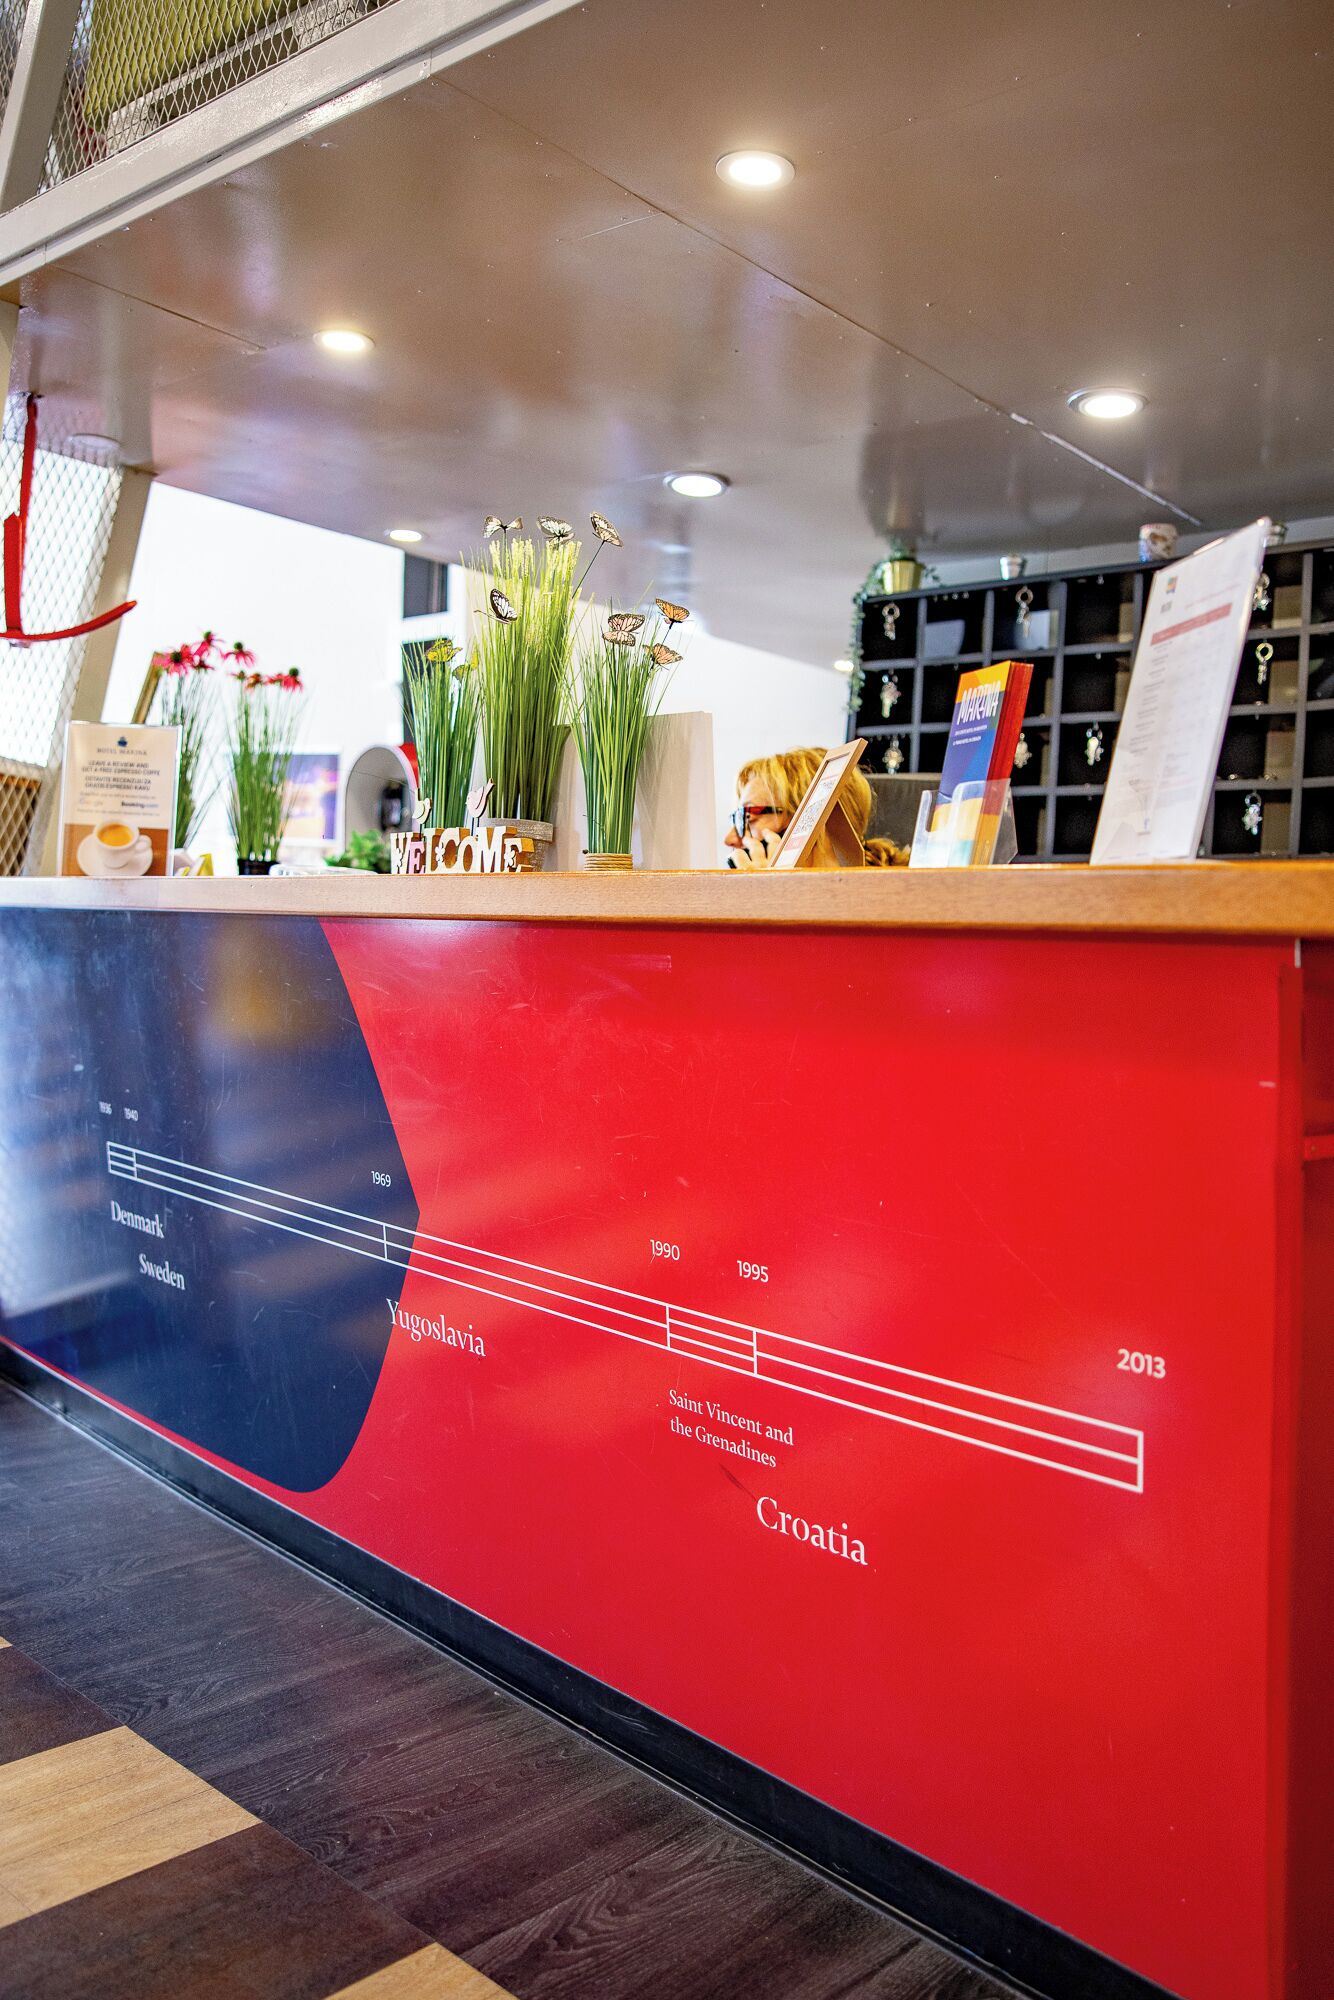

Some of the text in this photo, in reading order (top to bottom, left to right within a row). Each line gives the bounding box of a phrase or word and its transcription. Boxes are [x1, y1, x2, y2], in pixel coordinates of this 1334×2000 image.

[956, 680, 1000, 725] MARINA
[390, 826, 535, 874] WELCOME
[124, 1107, 139, 1121] 1940
[371, 1170, 392, 1187] 1969
[111, 1200, 164, 1238] Denmark
[650, 1239, 680, 1260] 1990
[139, 1253, 185, 1290] Sweden
[737, 1260, 769, 1282] 1995
[386, 1298, 486, 1356] Yugoslavia
[1117, 1348, 1166, 1379] 2013
[669, 1389, 793, 1446] Saint Vincent and
[670, 1417, 776, 1468] the Grenadines
[756, 1496, 868, 1566] Croatia
